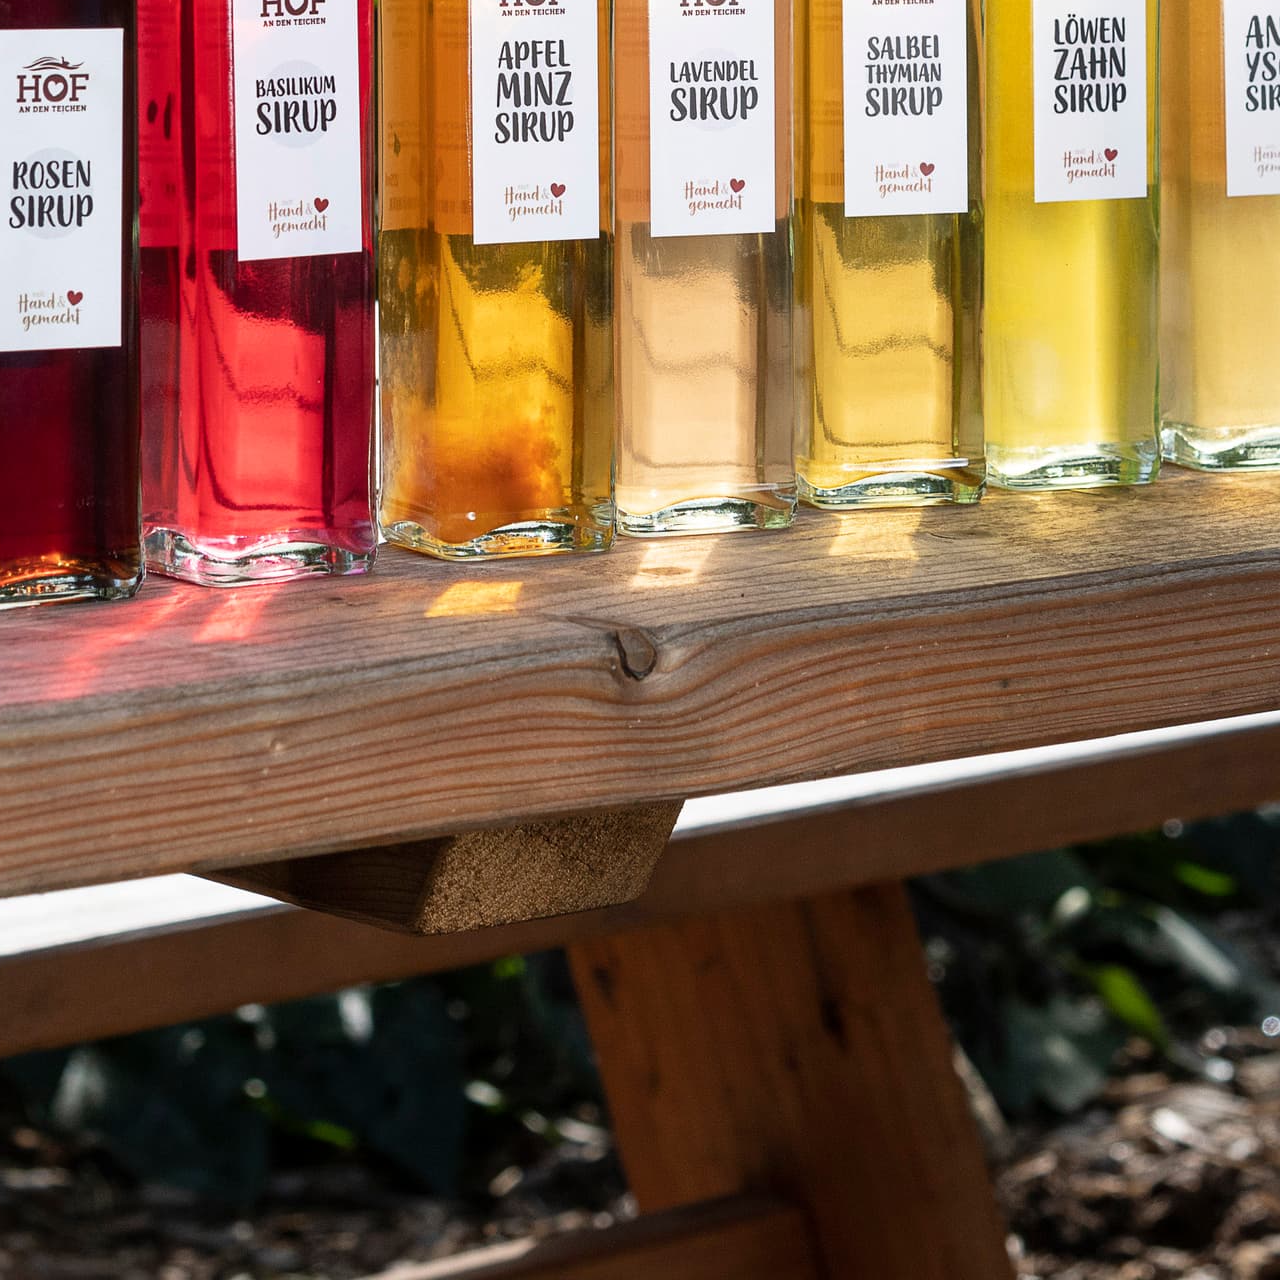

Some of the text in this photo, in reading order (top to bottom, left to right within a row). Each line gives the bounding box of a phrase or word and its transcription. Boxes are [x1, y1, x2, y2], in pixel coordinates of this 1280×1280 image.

[262, 17, 326, 28] AN DEN TEICHEN
[501, 7, 567, 17] AN DEN TEICHEN
[682, 9, 693, 17] AN
[712, 7, 747, 16] TEICHEN
[1053, 14, 1126, 46] LÖWEN
[497, 39, 571, 70] APFEL
[867, 34, 940, 61] SALBEI
[669, 59, 759, 84] LAVENDEL
[864, 63, 942, 84] THYMIAN
[1053, 45, 1127, 81] ZAHN
[16, 73, 89, 104] HOF
[255, 74, 336, 98] BASILIKUM
[495, 71, 573, 108] MINZ
[1053, 83, 1128, 114] SIRUP
[18, 104, 87, 113] AN DEN TEICHEN
[669, 86, 759, 122] SIRUP
[864, 86, 943, 118] SIRUP
[255, 98, 337, 136] SIRUP
[494, 109, 574, 144] SIRUP
[1062, 149, 1095, 169] Hand
[12, 160, 91, 190] ROSEN
[874, 165, 909, 184] Hand
[1065, 162, 1116, 183] gemacht
[503, 183, 540, 204] Hand
[684, 180, 720, 200] Hand
[878, 177, 932, 199] gemacht
[8, 193, 94, 229] SIRUP
[268, 196, 304, 222] Hand
[507, 198, 564, 221] gemacht
[688, 194, 744, 216] gemacht
[272, 212, 328, 239] gemacht
[18, 290, 57, 314] Hand
[21, 305, 83, 330] gemacht
